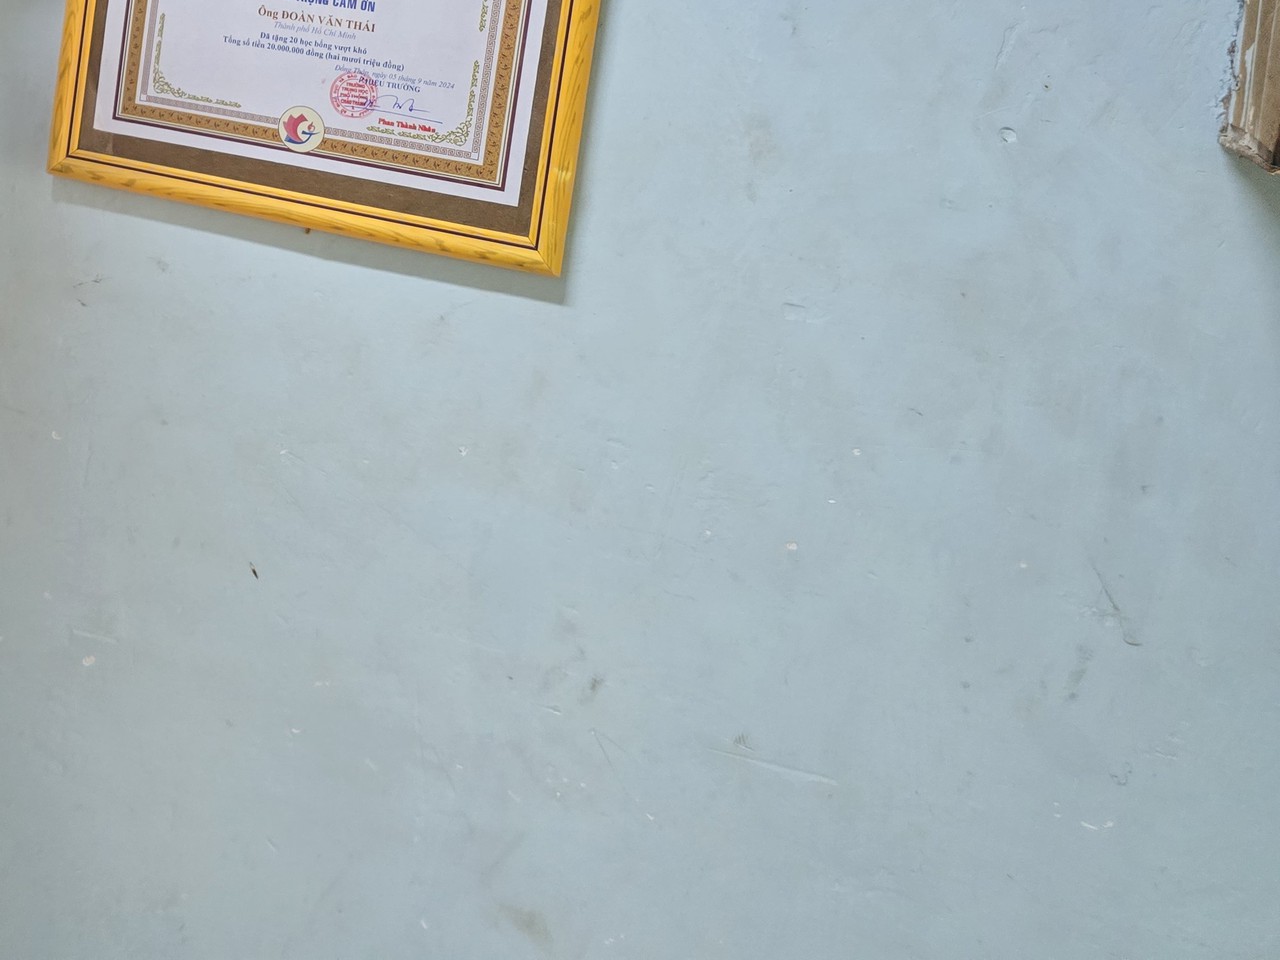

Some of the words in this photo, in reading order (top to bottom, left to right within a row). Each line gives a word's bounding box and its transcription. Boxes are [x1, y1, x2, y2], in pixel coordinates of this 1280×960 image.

[360, 0, 375, 12] ƠN
[258, 4, 278, 20] Ông
[281, 10, 314, 23] ĐOÀN
[318, 14, 342, 27] VĂN
[345, 19, 375, 32] THÁI
[274, 20, 295, 31] Thành
[295, 24, 310, 33] phố
[311, 26, 322, 34] Hồ
[323, 28, 336, 37] Chí
[337, 30, 356, 40] Minh
[260, 31, 270, 39] Đã
[271, 34, 288, 44] tặng
[289, 36, 298, 44] 20
[299, 37, 312, 47] học
[314, 39, 332, 50] bổng
[334, 44, 351, 53] vượt
[352, 46, 367, 54] khó
[223, 35, 241, 46] Tổng
[242, 37, 250, 46] số
[251, 39, 265, 48] tiền
[266, 42, 304, 54] 20.000.000
[305, 48, 323, 59] đồng
[325, 52, 340, 60] (hai
[341, 56, 361, 64] mươi
[362, 58, 380, 67] triệu
[382, 59, 404, 71] đồng)
[371, 71, 387, 80] ngày
[397, 74, 416, 84] tháng
[438, 80, 455, 89] 2024
[387, 81, 420, 92] TRƯỞNG
